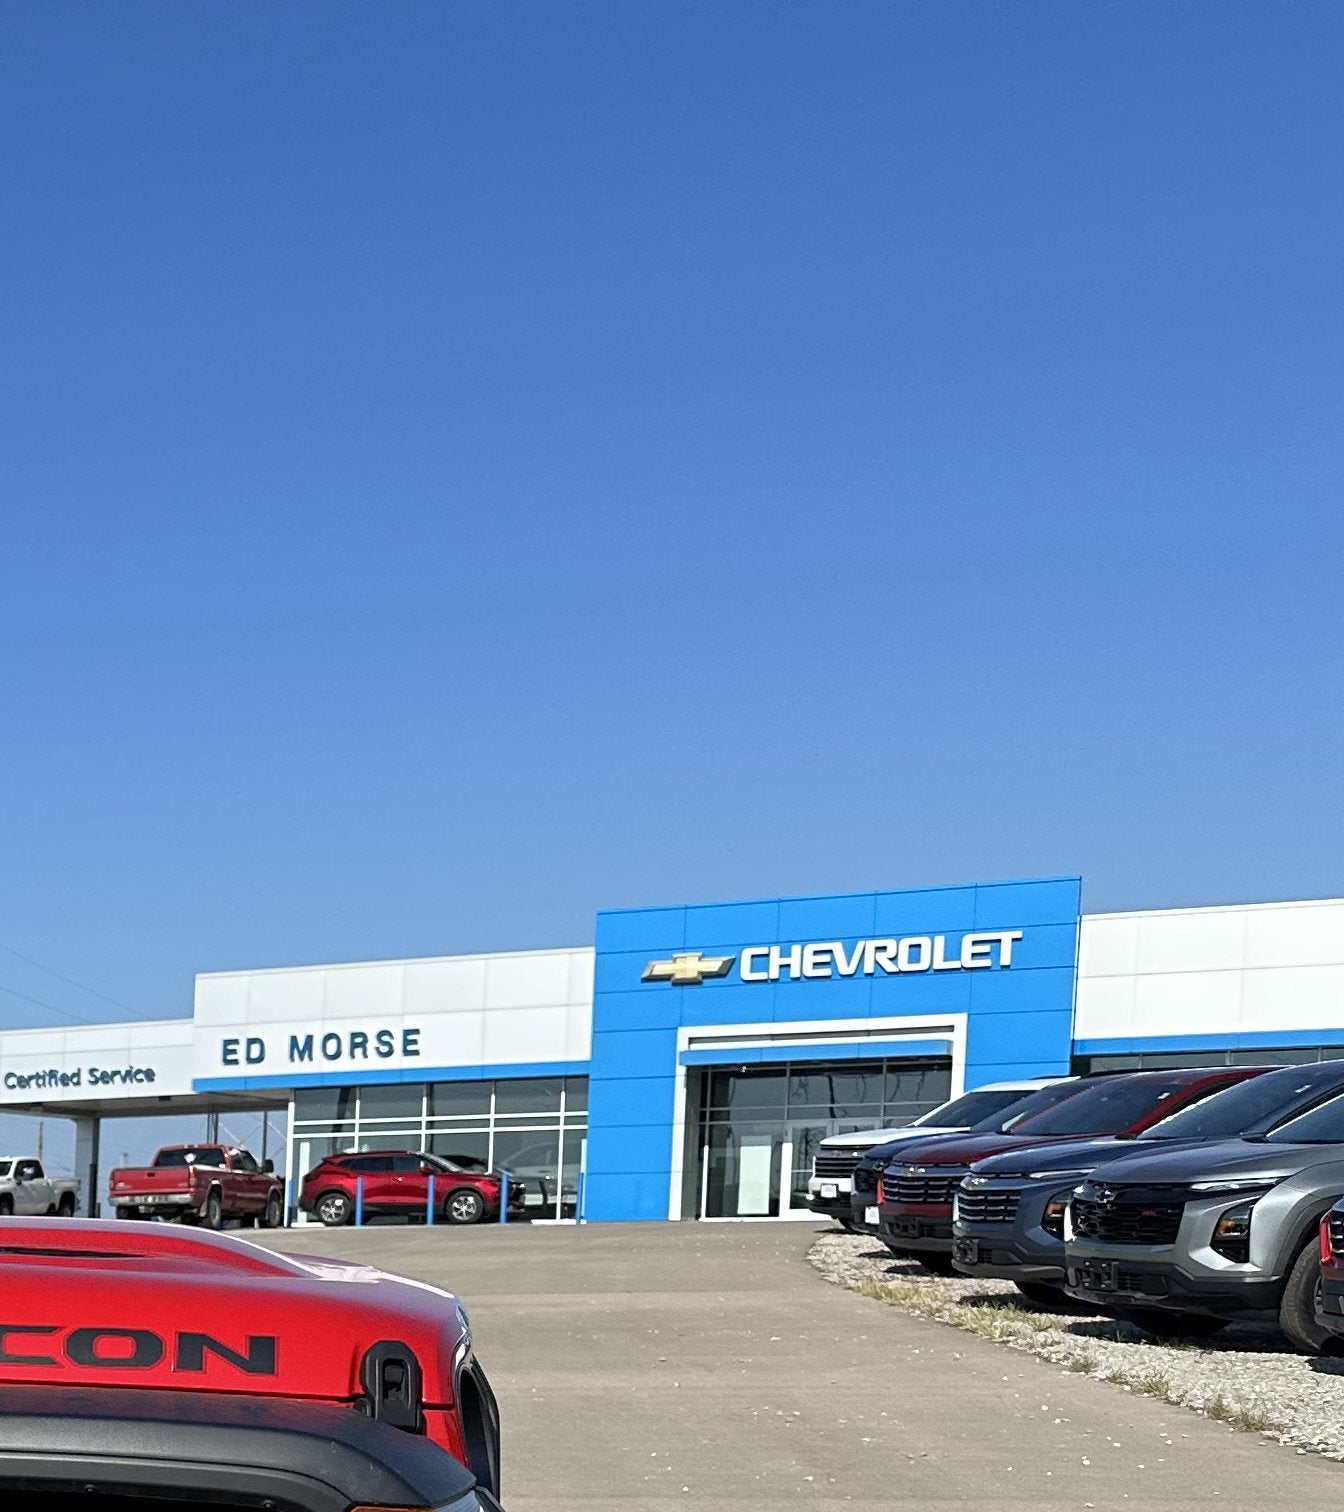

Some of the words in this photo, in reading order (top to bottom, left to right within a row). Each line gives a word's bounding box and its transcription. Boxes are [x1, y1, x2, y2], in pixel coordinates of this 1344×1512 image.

[740, 930, 1023, 983] CHEVROLET
[221, 1037, 266, 1066] ED
[289, 1028, 421, 1063] MORSE
[4, 1067, 81, 1090] Certified
[88, 1064, 156, 1086] Service
